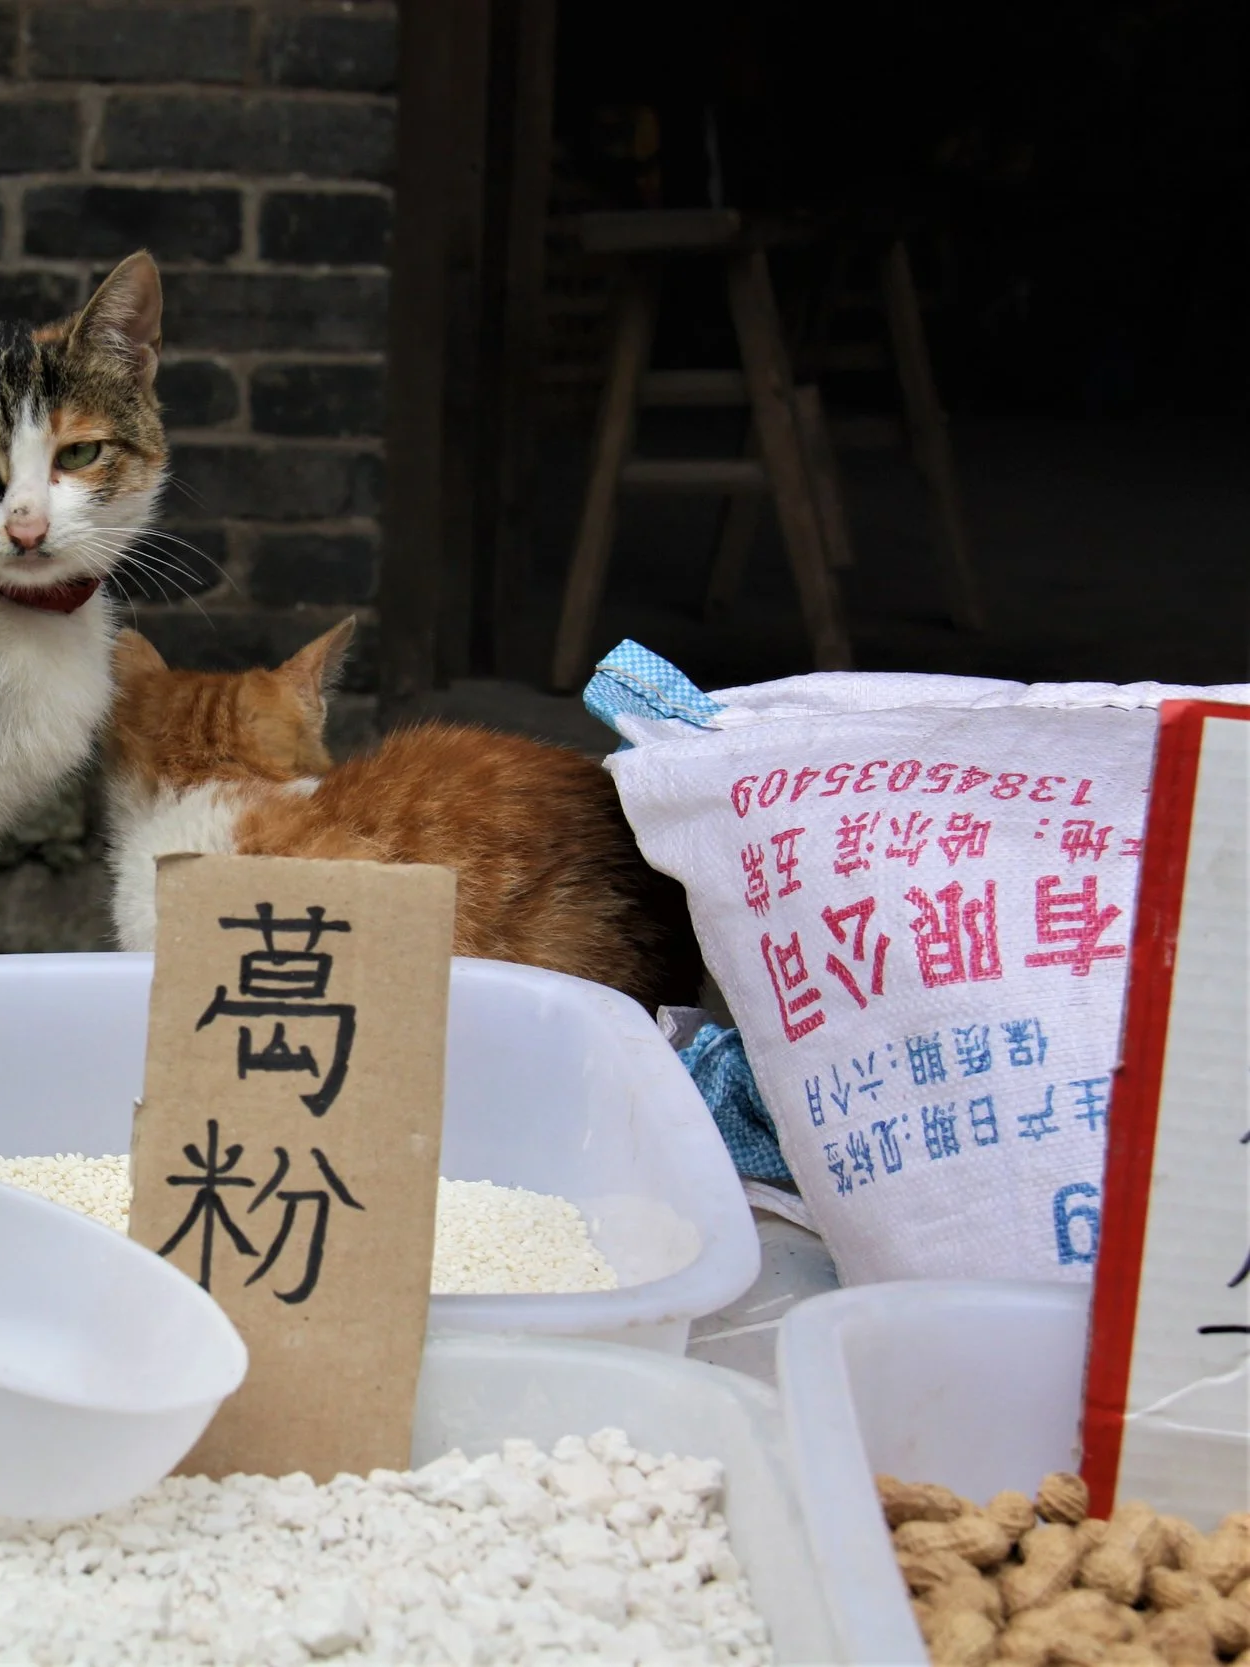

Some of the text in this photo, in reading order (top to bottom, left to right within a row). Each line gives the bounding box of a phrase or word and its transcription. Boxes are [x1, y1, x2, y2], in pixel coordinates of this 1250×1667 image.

[732, 760, 1093, 818] 13845035409
[760, 875, 1127, 1042] 有限公司
[805, 1017, 1048, 1127] 保质期：六个月
